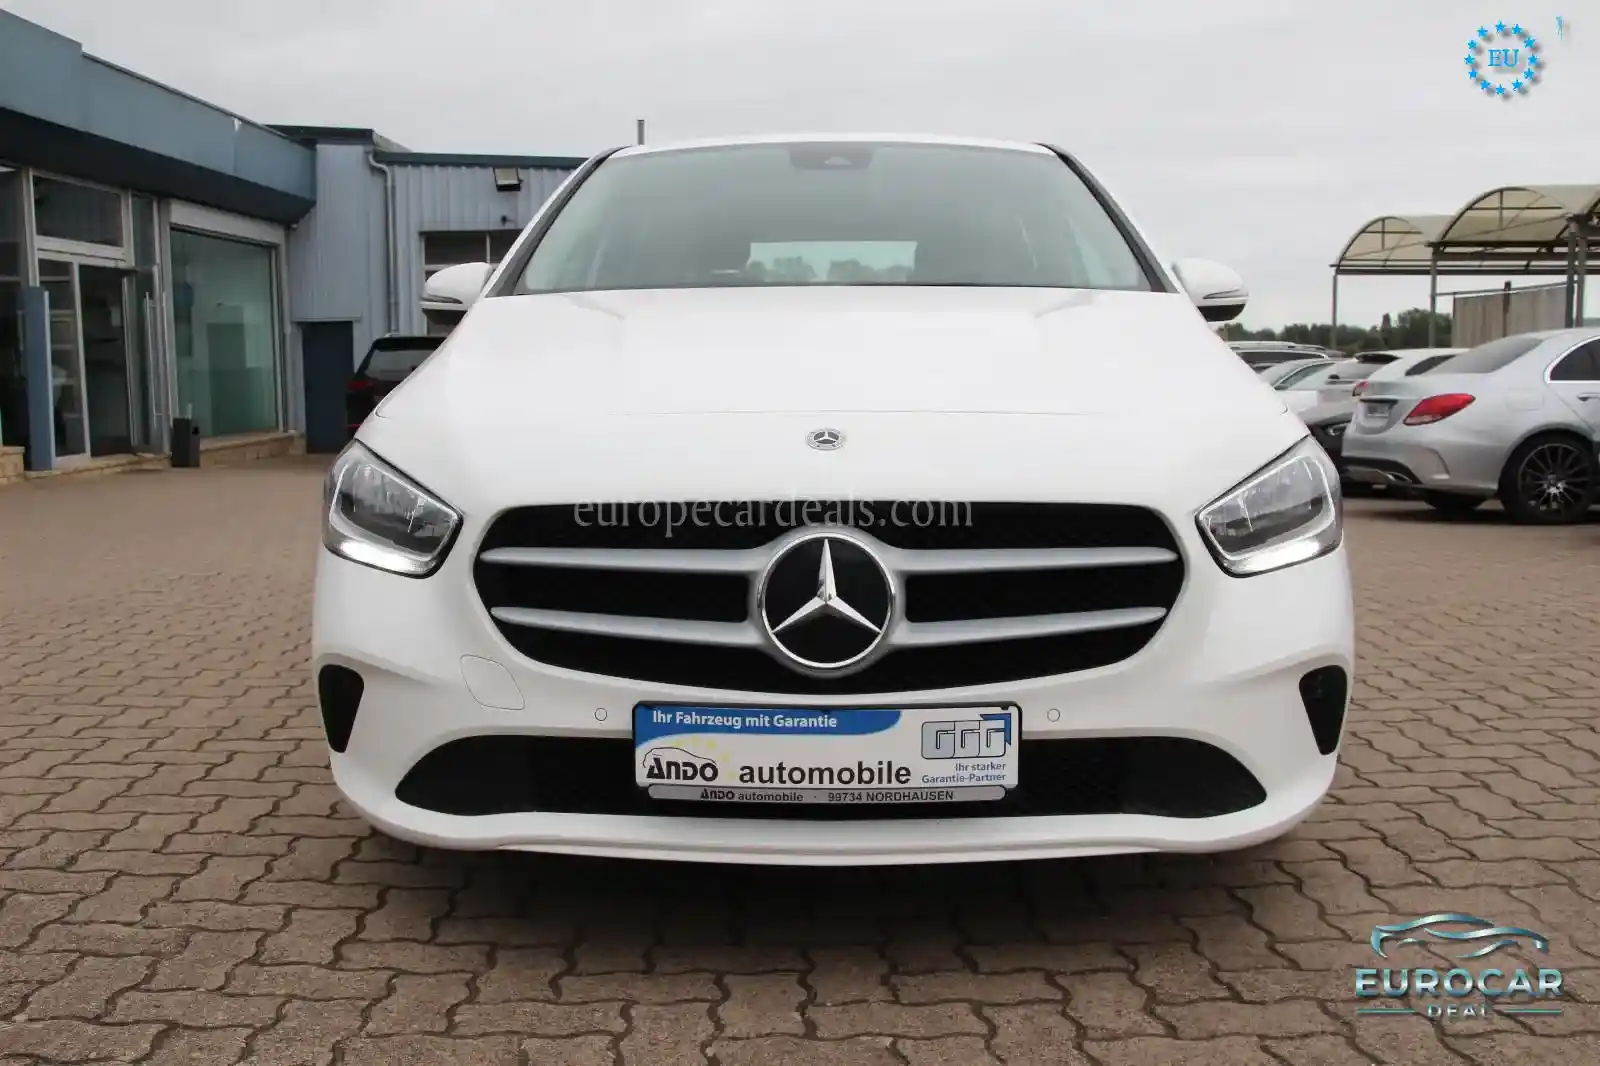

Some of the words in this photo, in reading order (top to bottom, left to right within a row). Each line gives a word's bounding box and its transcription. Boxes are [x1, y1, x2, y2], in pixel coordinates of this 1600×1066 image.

[652, 710, 673, 725] Ihr
[675, 711, 742, 729] Fahrzeug
[745, 714, 771, 728] mit
[773, 714, 838, 729] Garantie
[738, 760, 912, 785] automobile
[954, 762, 969, 772] Ihr
[971, 761, 1007, 772] starker
[921, 772, 1007, 784] Garantie-Partner
[738, 790, 804, 802] automobile
[827, 791, 863, 802] 99734
[866, 790, 954, 802] NORDHAUSEN
